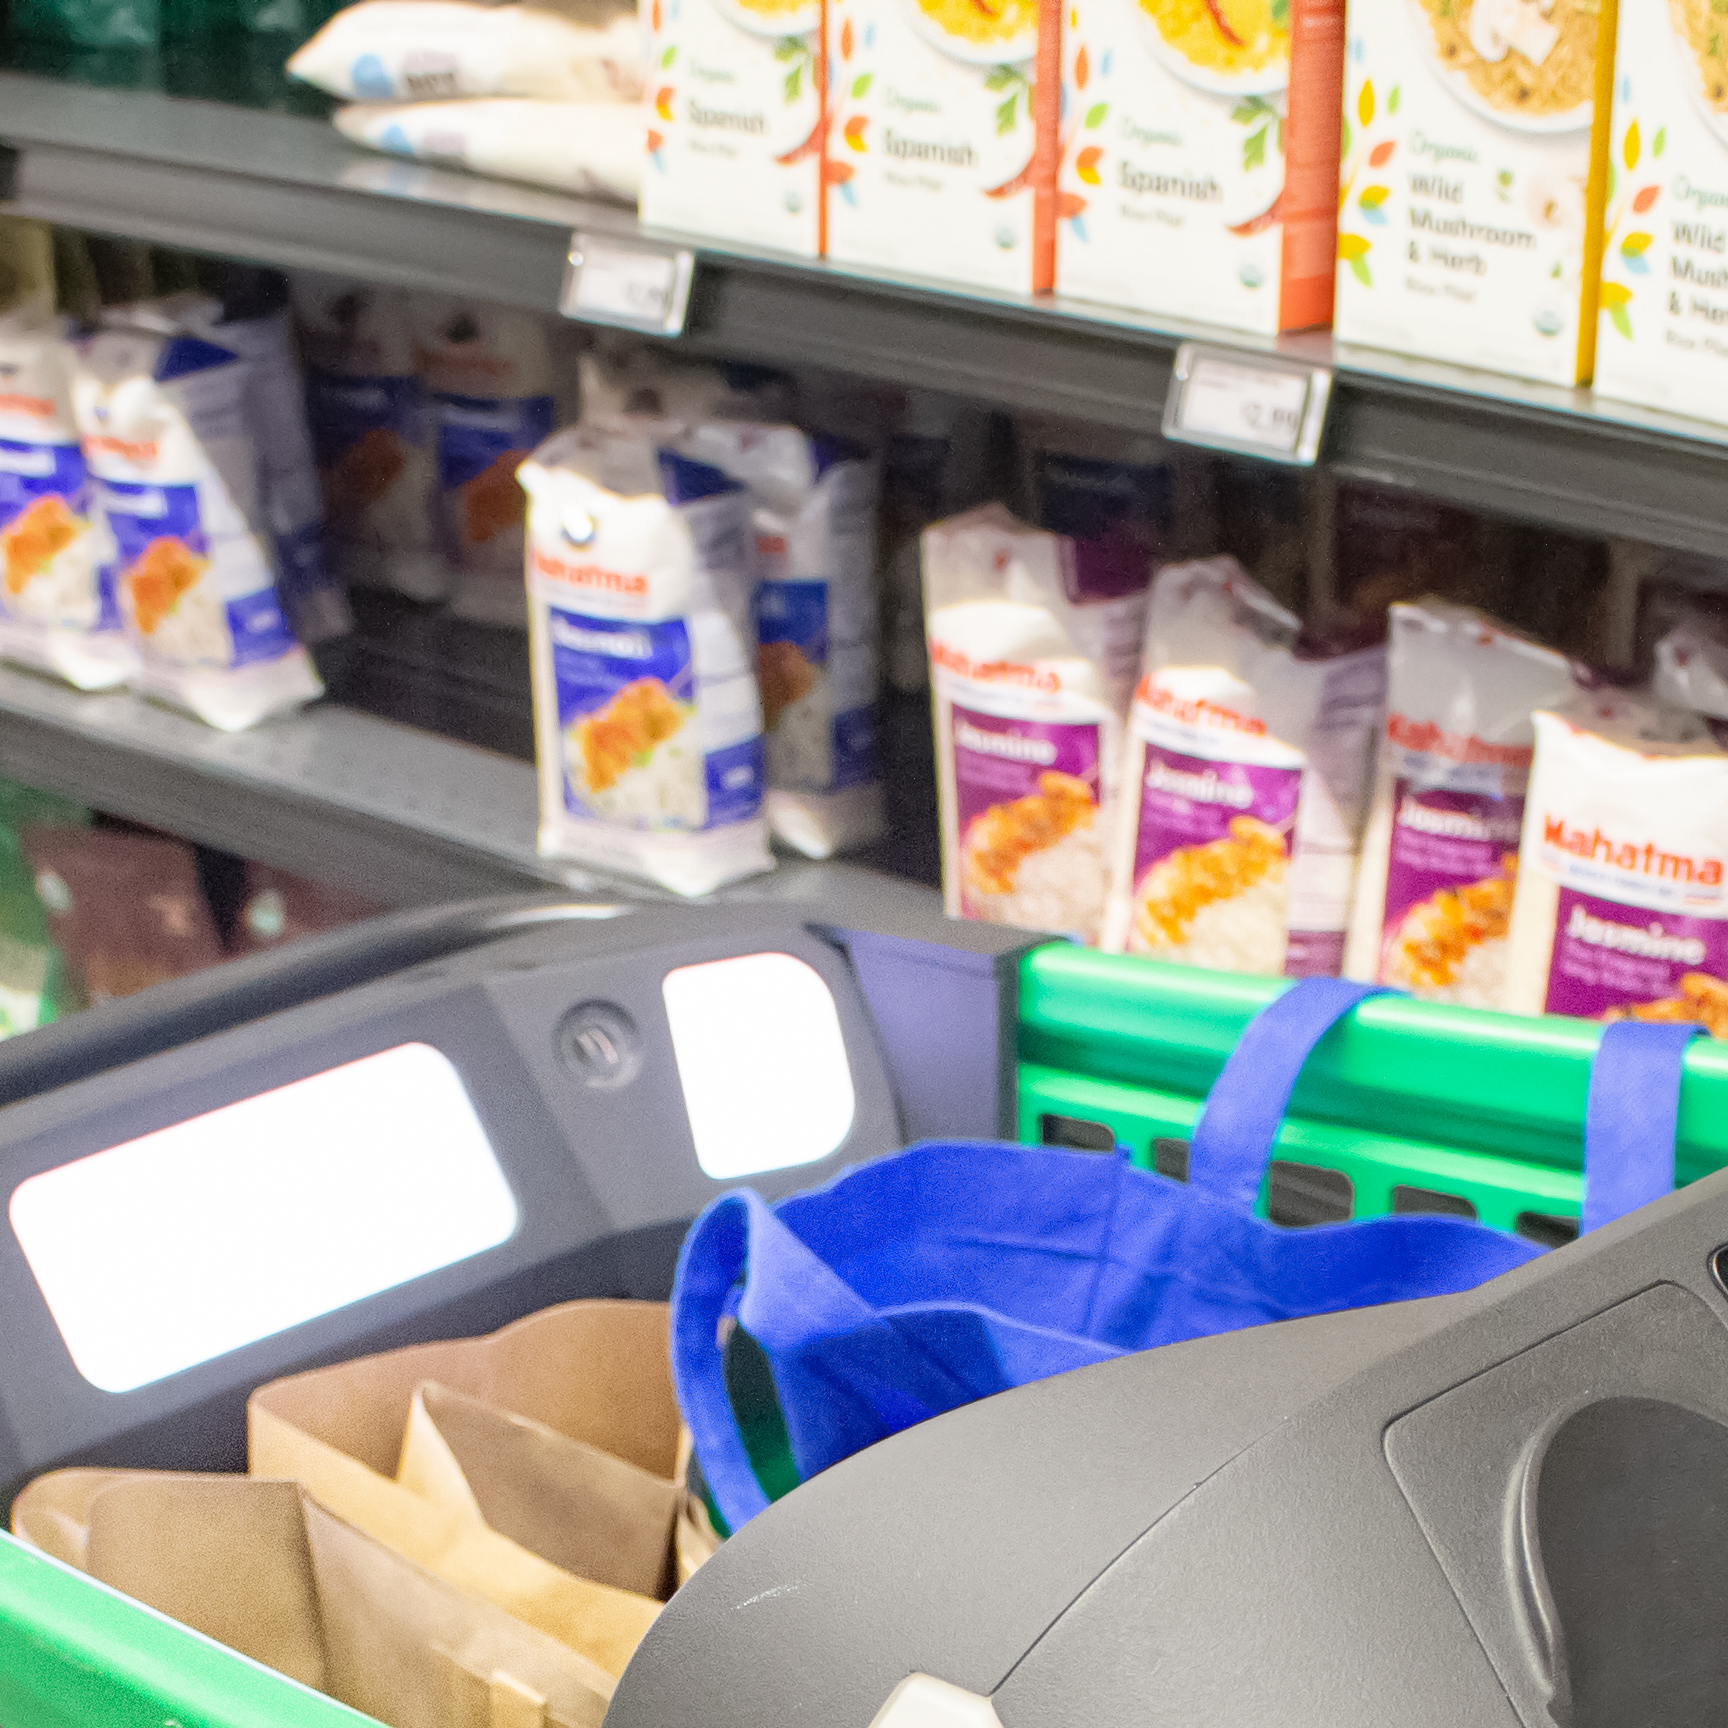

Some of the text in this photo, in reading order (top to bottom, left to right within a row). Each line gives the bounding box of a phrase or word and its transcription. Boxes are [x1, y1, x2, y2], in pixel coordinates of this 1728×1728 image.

[883, 129, 979, 168] Spanish
[1119, 159, 1222, 203] Spanish
[1408, 172, 1463, 205] Wild
[1408, 204, 1537, 251] Mushroom
[1671, 221, 1726, 254] Wild
[1408, 239, 1486, 276] & Herb
[1669, 290, 1681, 316] &
[1543, 813, 1724, 886] Mahatma
[1566, 904, 1707, 966] Jasmine
